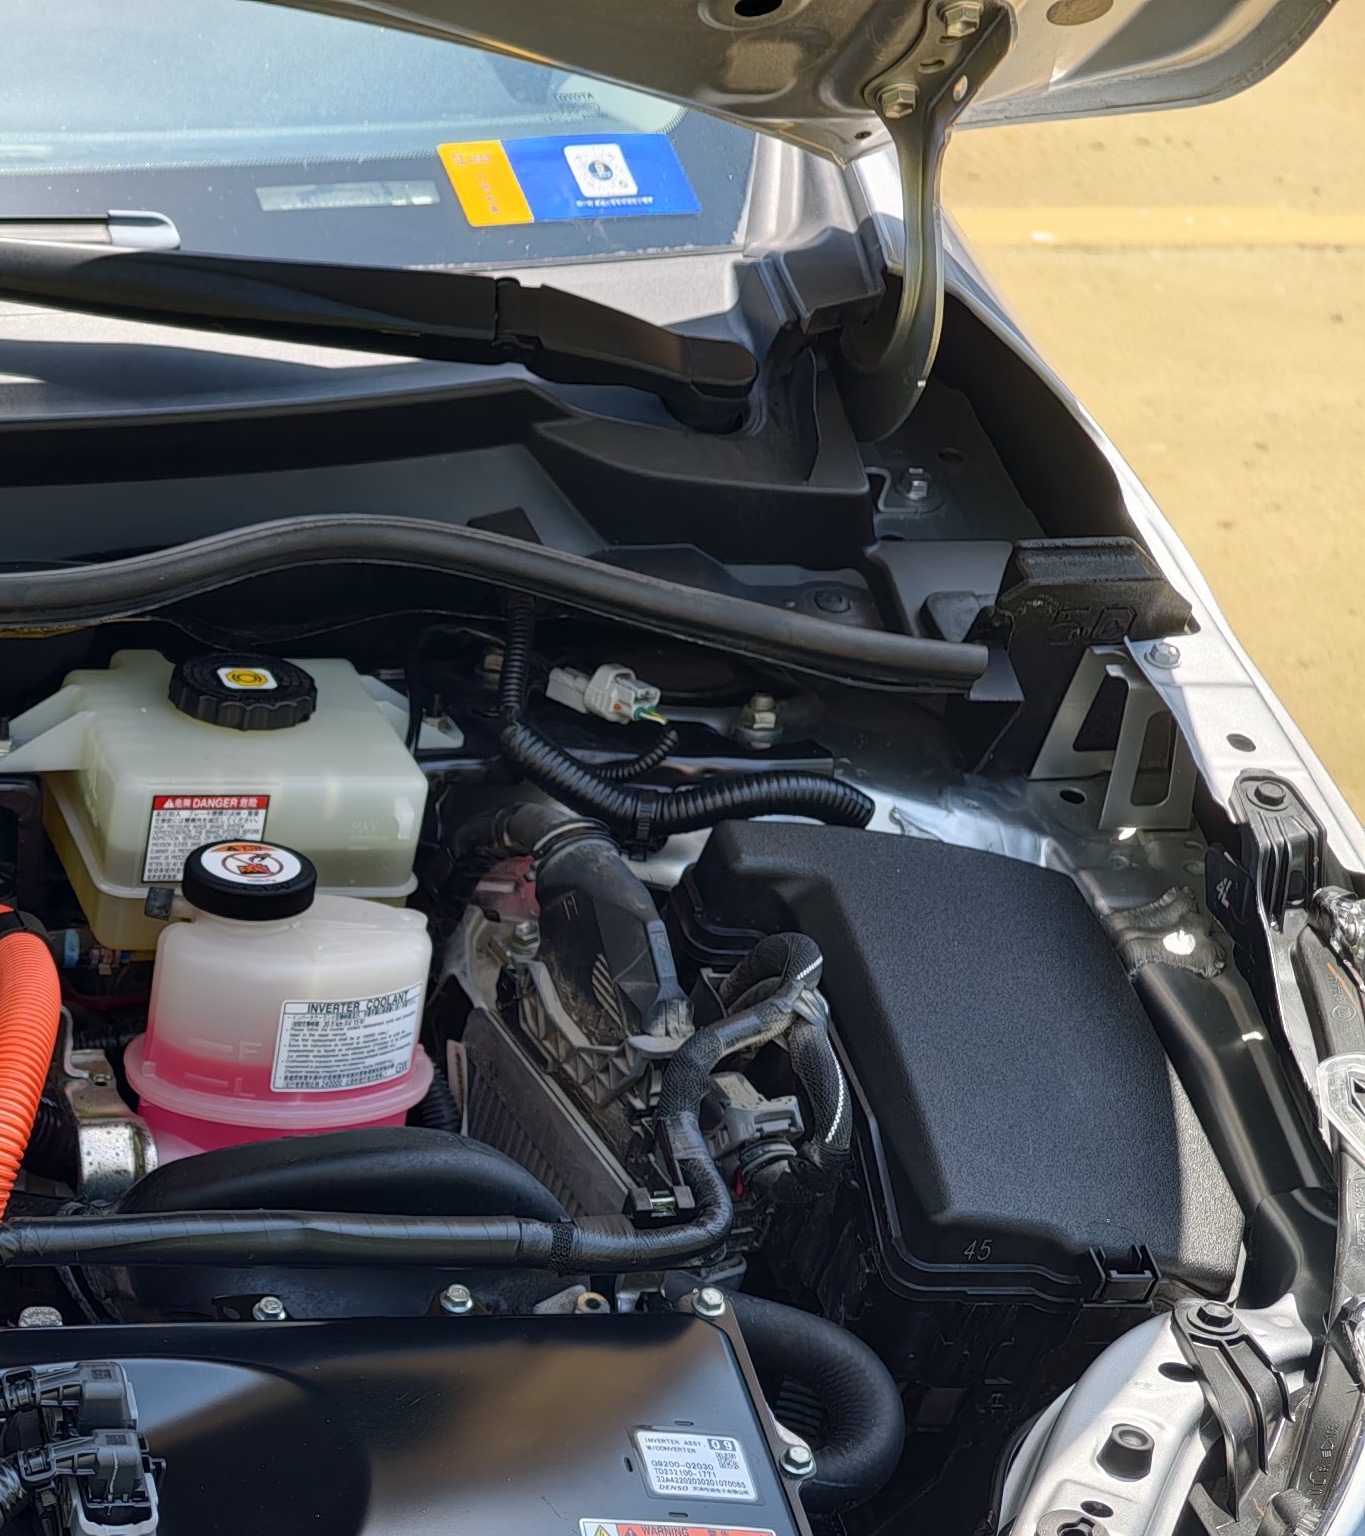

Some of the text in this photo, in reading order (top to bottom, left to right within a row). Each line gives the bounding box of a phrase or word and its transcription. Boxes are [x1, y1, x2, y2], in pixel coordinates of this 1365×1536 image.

[192, 798, 238, 808] DANGER
[308, 990, 409, 1014] INVERTER COOLANT
[238, 1040, 263, 1061] F
[234, 1076, 257, 1098] L
[963, 1239, 993, 1261] 45
[645, 1437, 680, 1445] INVERTER
[646, 1445, 697, 1454] W/CONVERTER
[651, 1460, 714, 1471] G9200-02030
[655, 1468, 717, 1478] TD232100-1771
[659, 1484, 689, 1492] DENSO
[641, 1526, 689, 1536] WARNING
